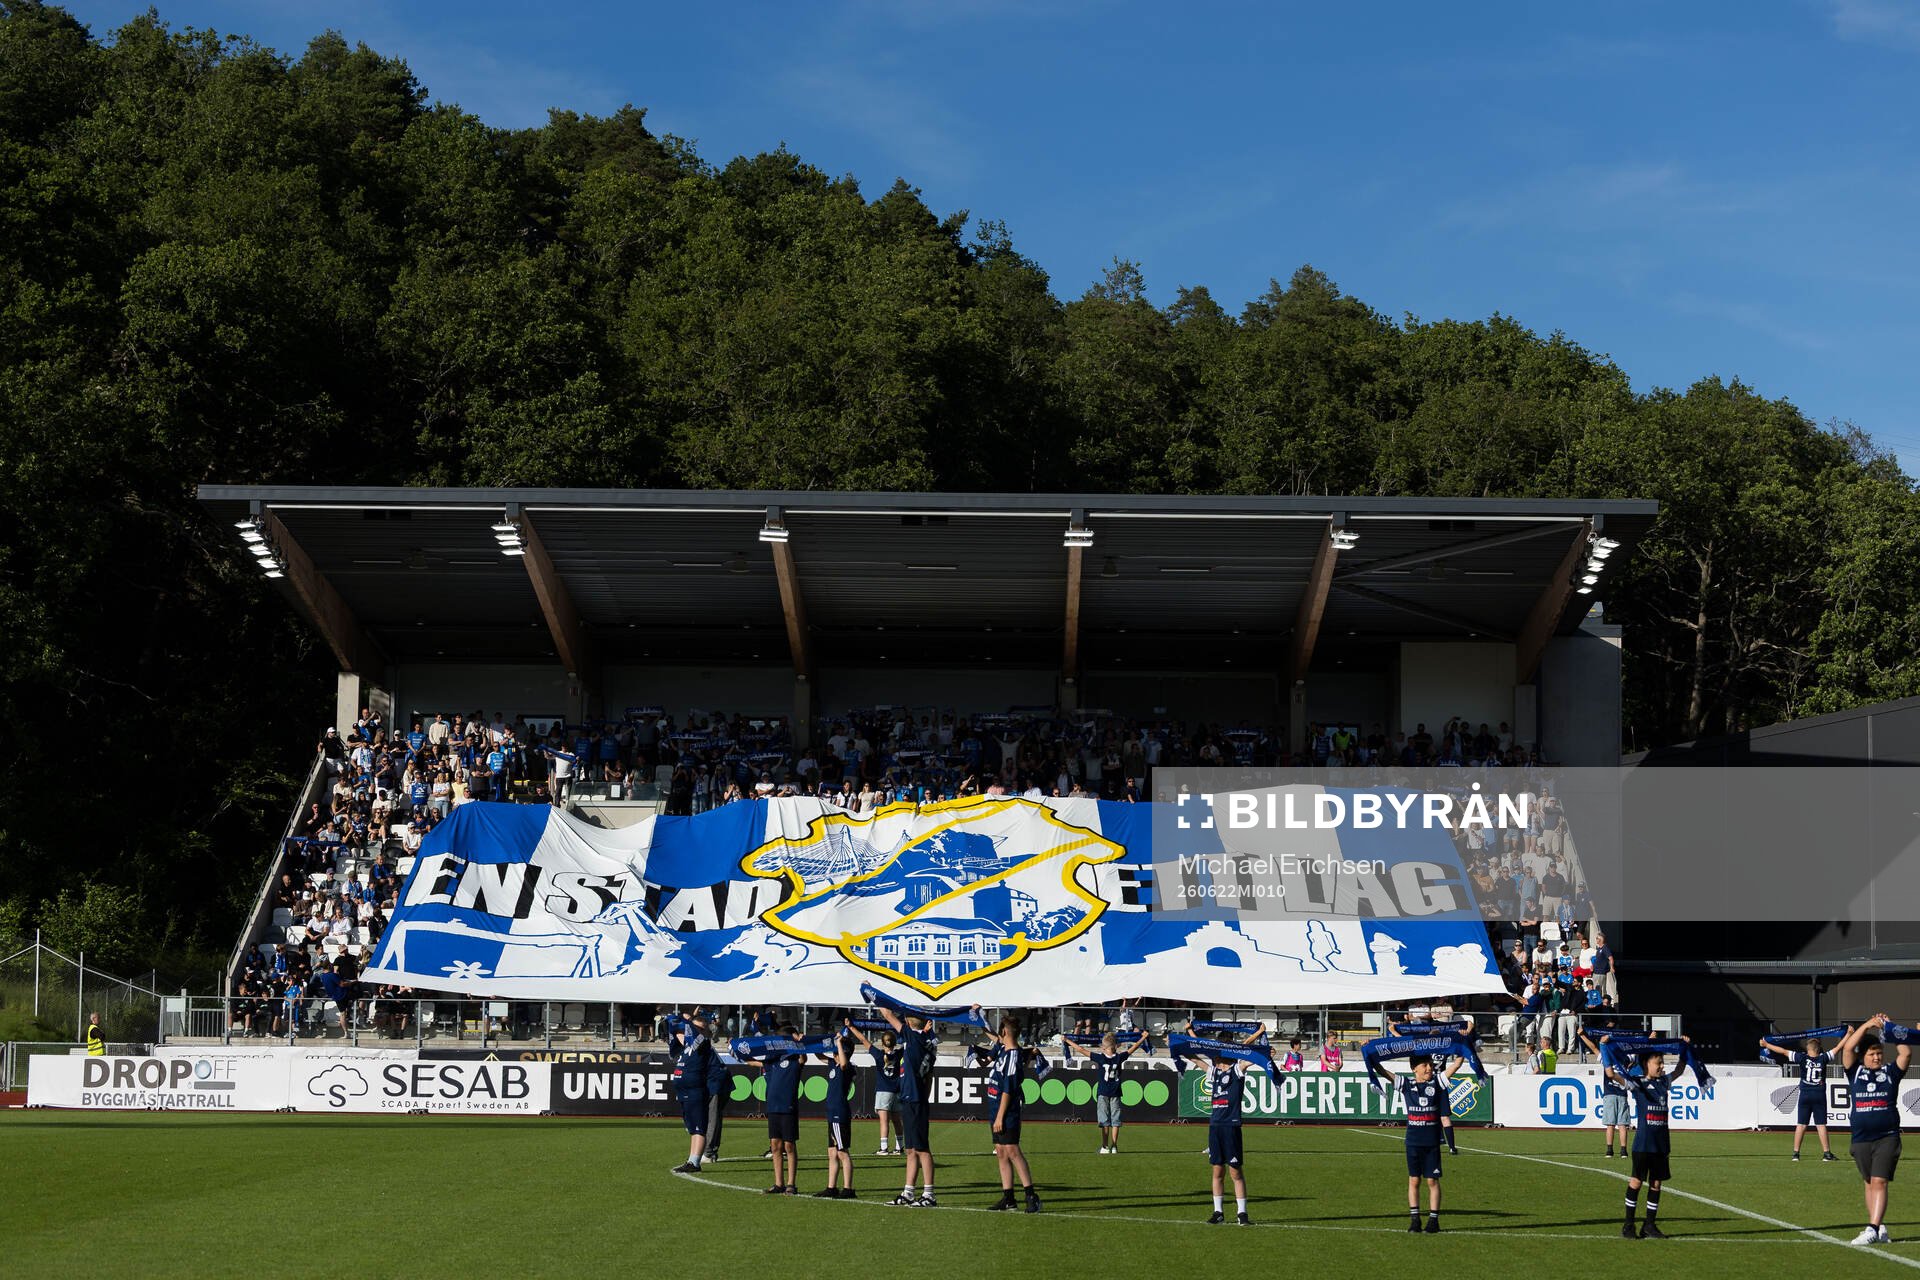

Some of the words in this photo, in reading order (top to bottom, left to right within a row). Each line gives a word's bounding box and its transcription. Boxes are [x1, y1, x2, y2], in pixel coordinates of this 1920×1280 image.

[403, 853, 541, 919] EN
[82, 1089, 235, 1108] BYGGMÄSTARTRALL
[382, 1064, 530, 1099] SESAB
[1240, 1075, 1408, 1115] SUPERETTA
[381, 1100, 419, 1108] SCADA
[425, 1101, 461, 1111] Expert
[466, 1101, 510, 1110] Sweden
[516, 1102, 529, 1110] AB
